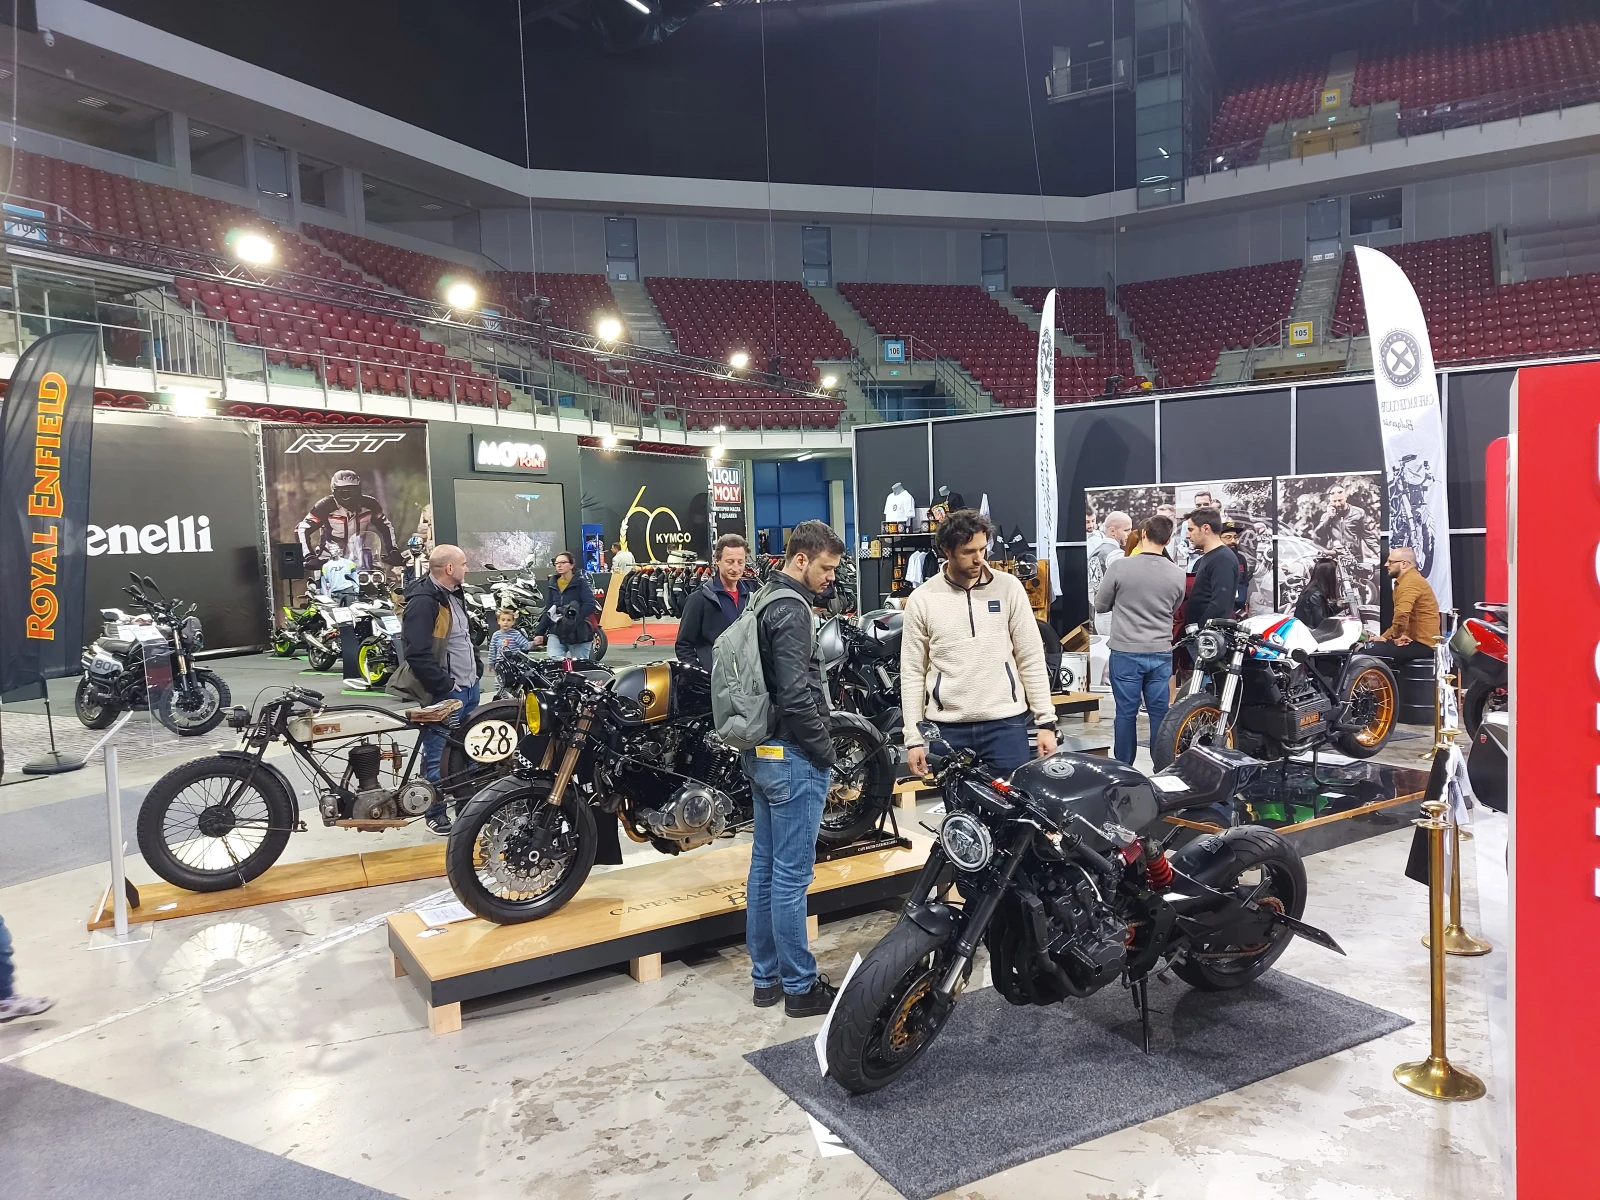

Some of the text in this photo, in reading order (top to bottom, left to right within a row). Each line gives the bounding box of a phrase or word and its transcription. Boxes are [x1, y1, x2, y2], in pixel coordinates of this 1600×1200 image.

[284, 433, 406, 453] RST
[477, 440, 546, 468] MOTO
[519, 458, 546, 468] POINT
[713, 468, 739, 485] LIQUI
[714, 486, 740, 501] MOLY
[27, 371, 67, 640] ROYAL ENFIELD
[87, 515, 214, 556] enelli
[656, 533, 691, 543] KYMCO
[609, 899, 667, 916] CAFE
[669, 885, 738, 903] RACER
